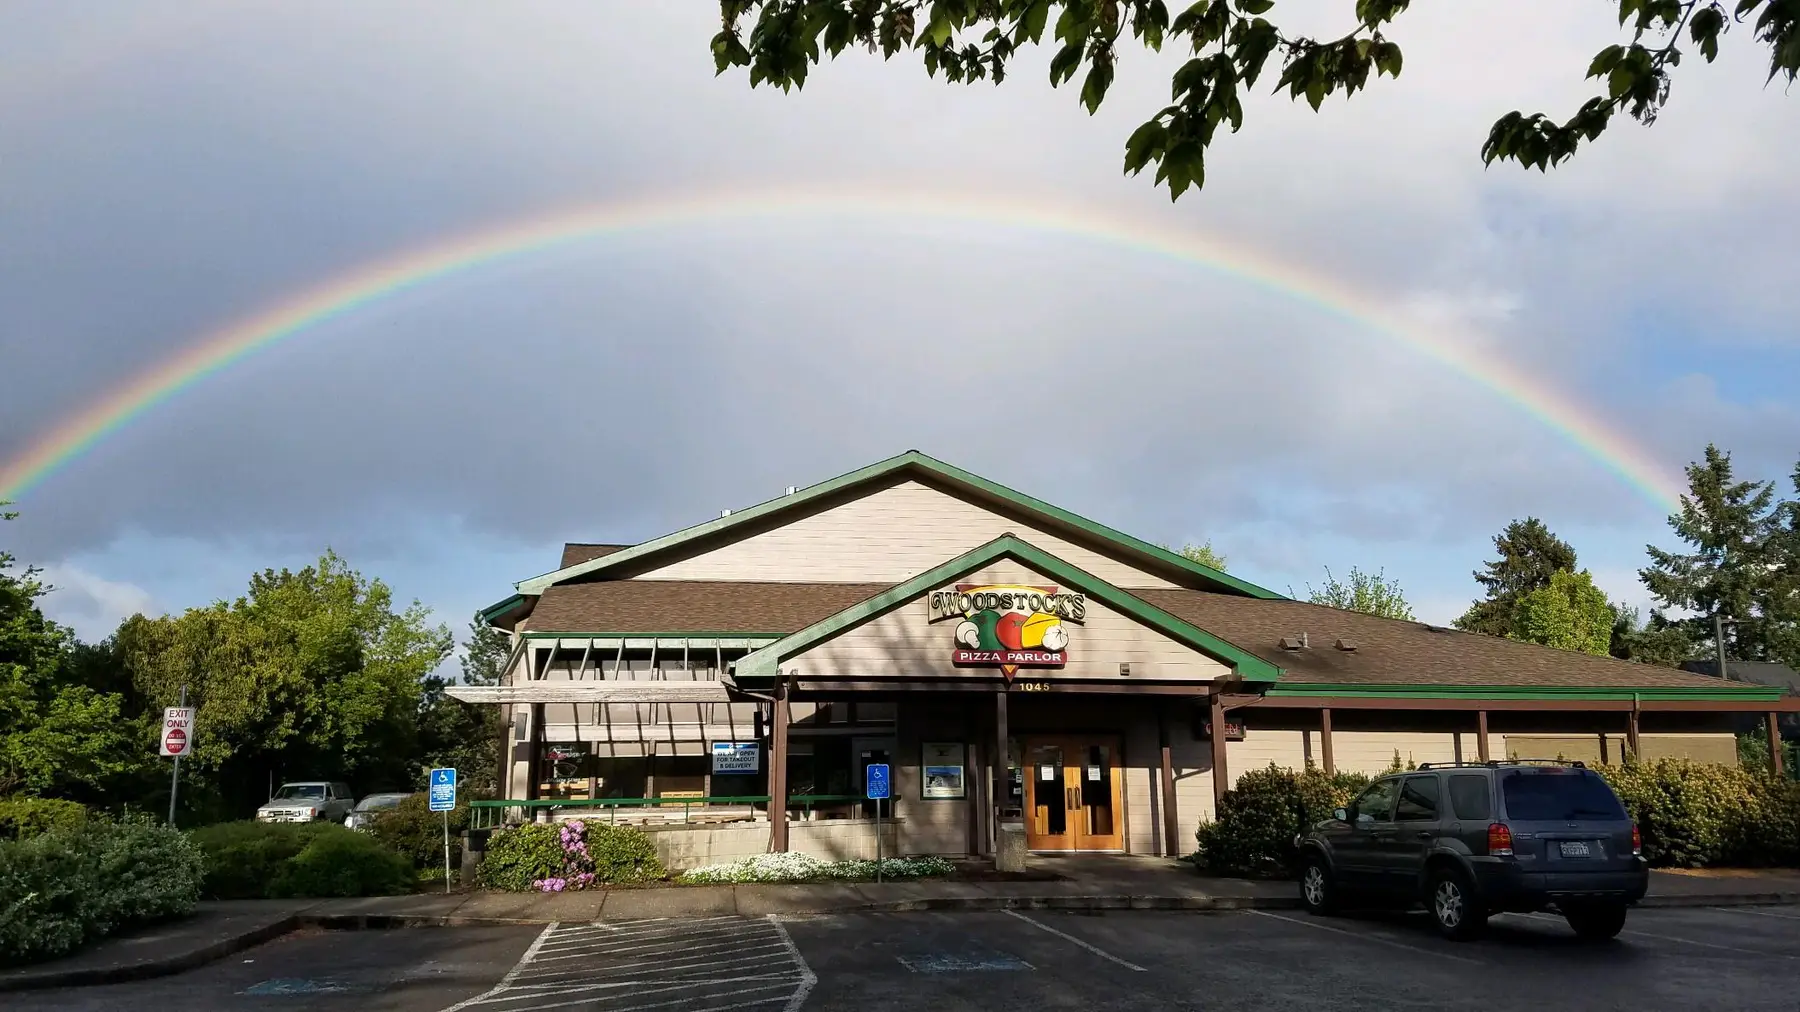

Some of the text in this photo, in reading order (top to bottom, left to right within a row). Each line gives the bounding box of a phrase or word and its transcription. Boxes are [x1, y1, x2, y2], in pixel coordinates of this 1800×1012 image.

[931, 592, 1086, 619] WOODSTOCK'S
[960, 652, 1061, 661] PIZZA PARLOR
[1020, 683, 1050, 691] 1045
